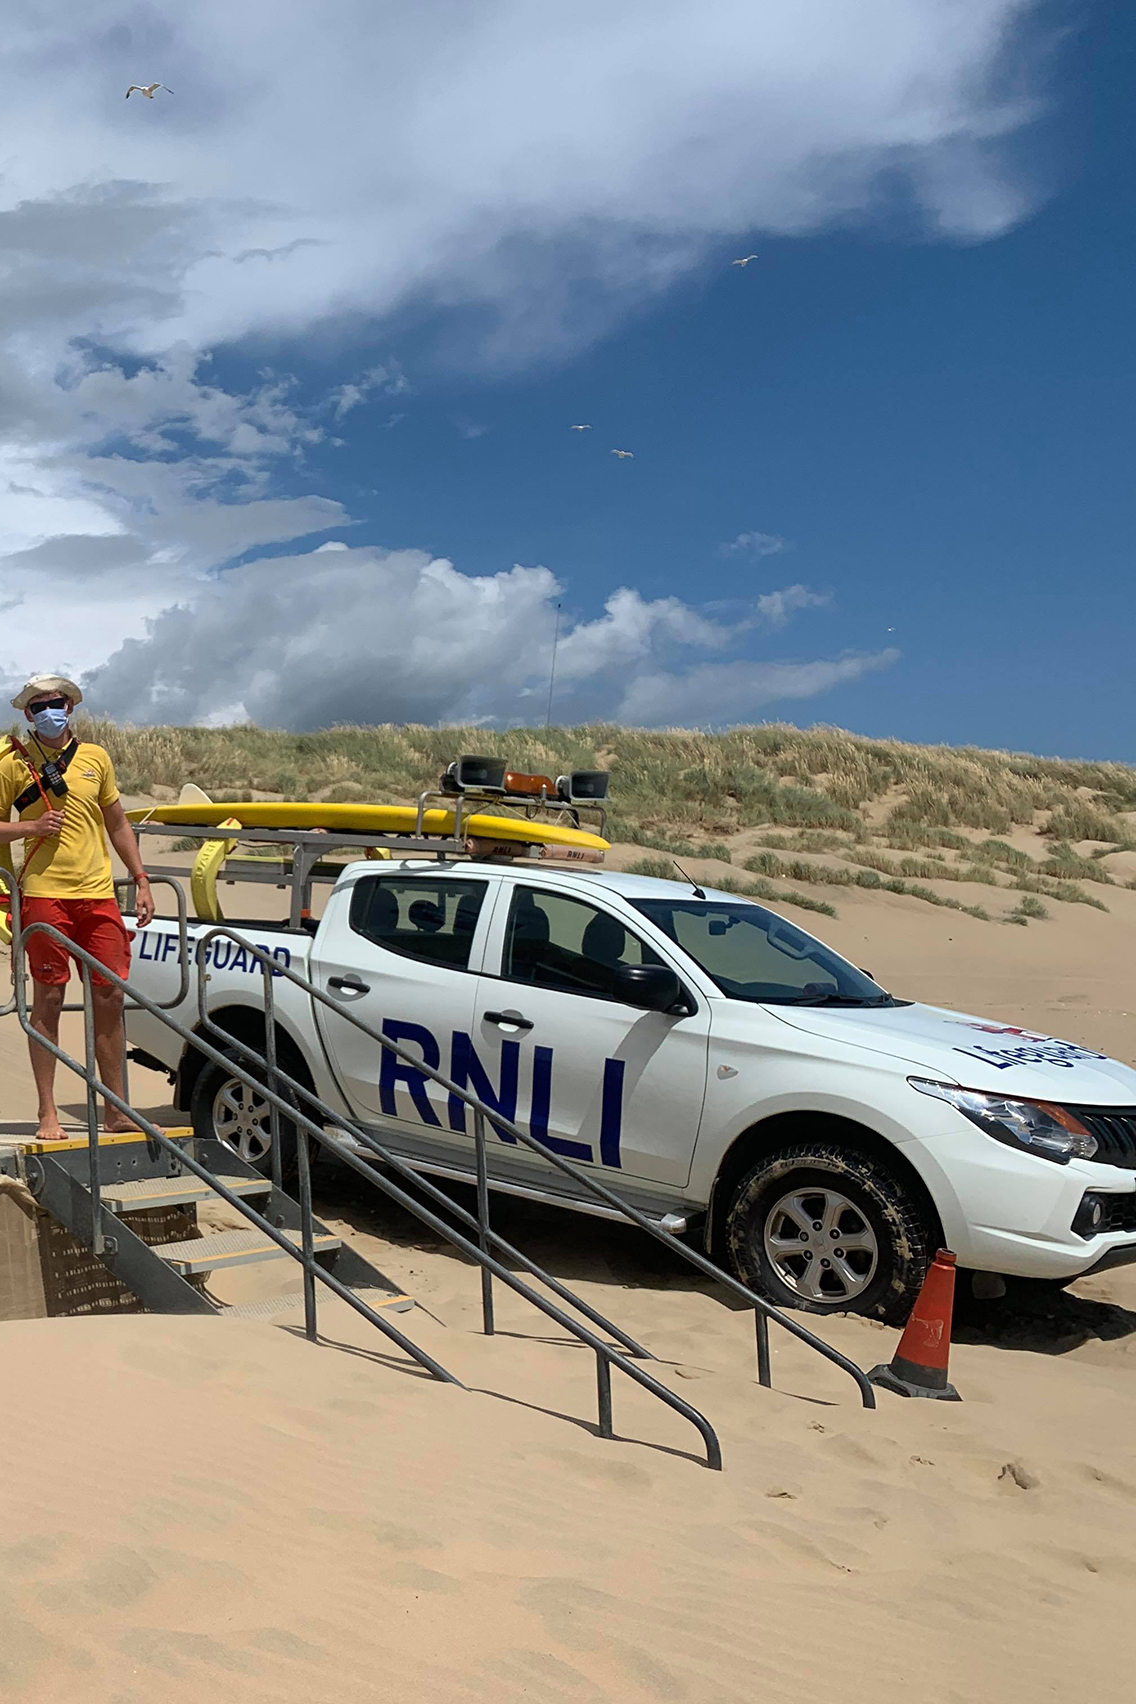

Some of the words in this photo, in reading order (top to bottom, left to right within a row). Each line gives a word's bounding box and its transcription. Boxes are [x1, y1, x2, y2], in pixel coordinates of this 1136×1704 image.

[567, 850, 585, 859] RNLI
[139, 931, 291, 977] LIFEGUARD
[952, 1041, 1107, 1069] Lifeguard
[379, 1018, 625, 1169] RNLI
